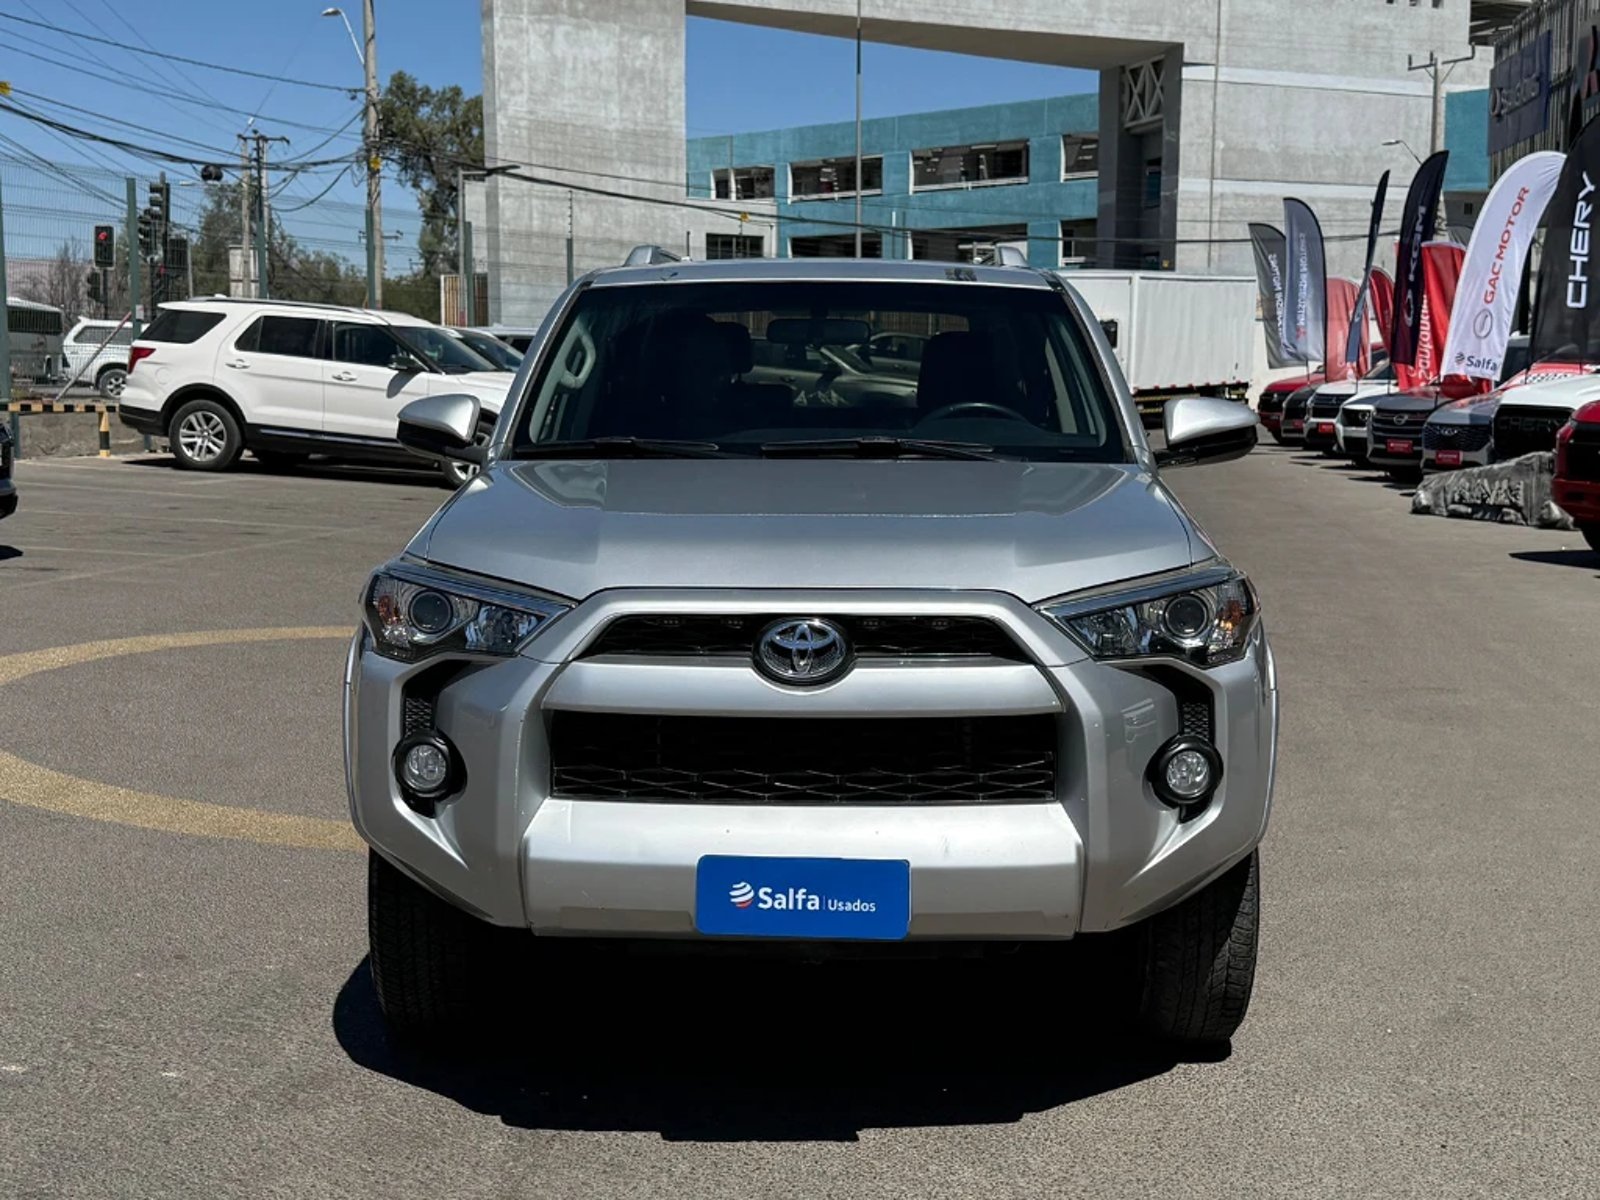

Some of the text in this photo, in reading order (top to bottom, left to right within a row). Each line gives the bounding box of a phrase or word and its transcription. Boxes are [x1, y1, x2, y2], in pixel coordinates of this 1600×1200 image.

[1483, 186, 1530, 305] GAC MOTOR
[1566, 171, 1596, 309] CHERY
[1466, 355, 1498, 372] Salfa
[758, 887, 876, 912] Salfa Usados
